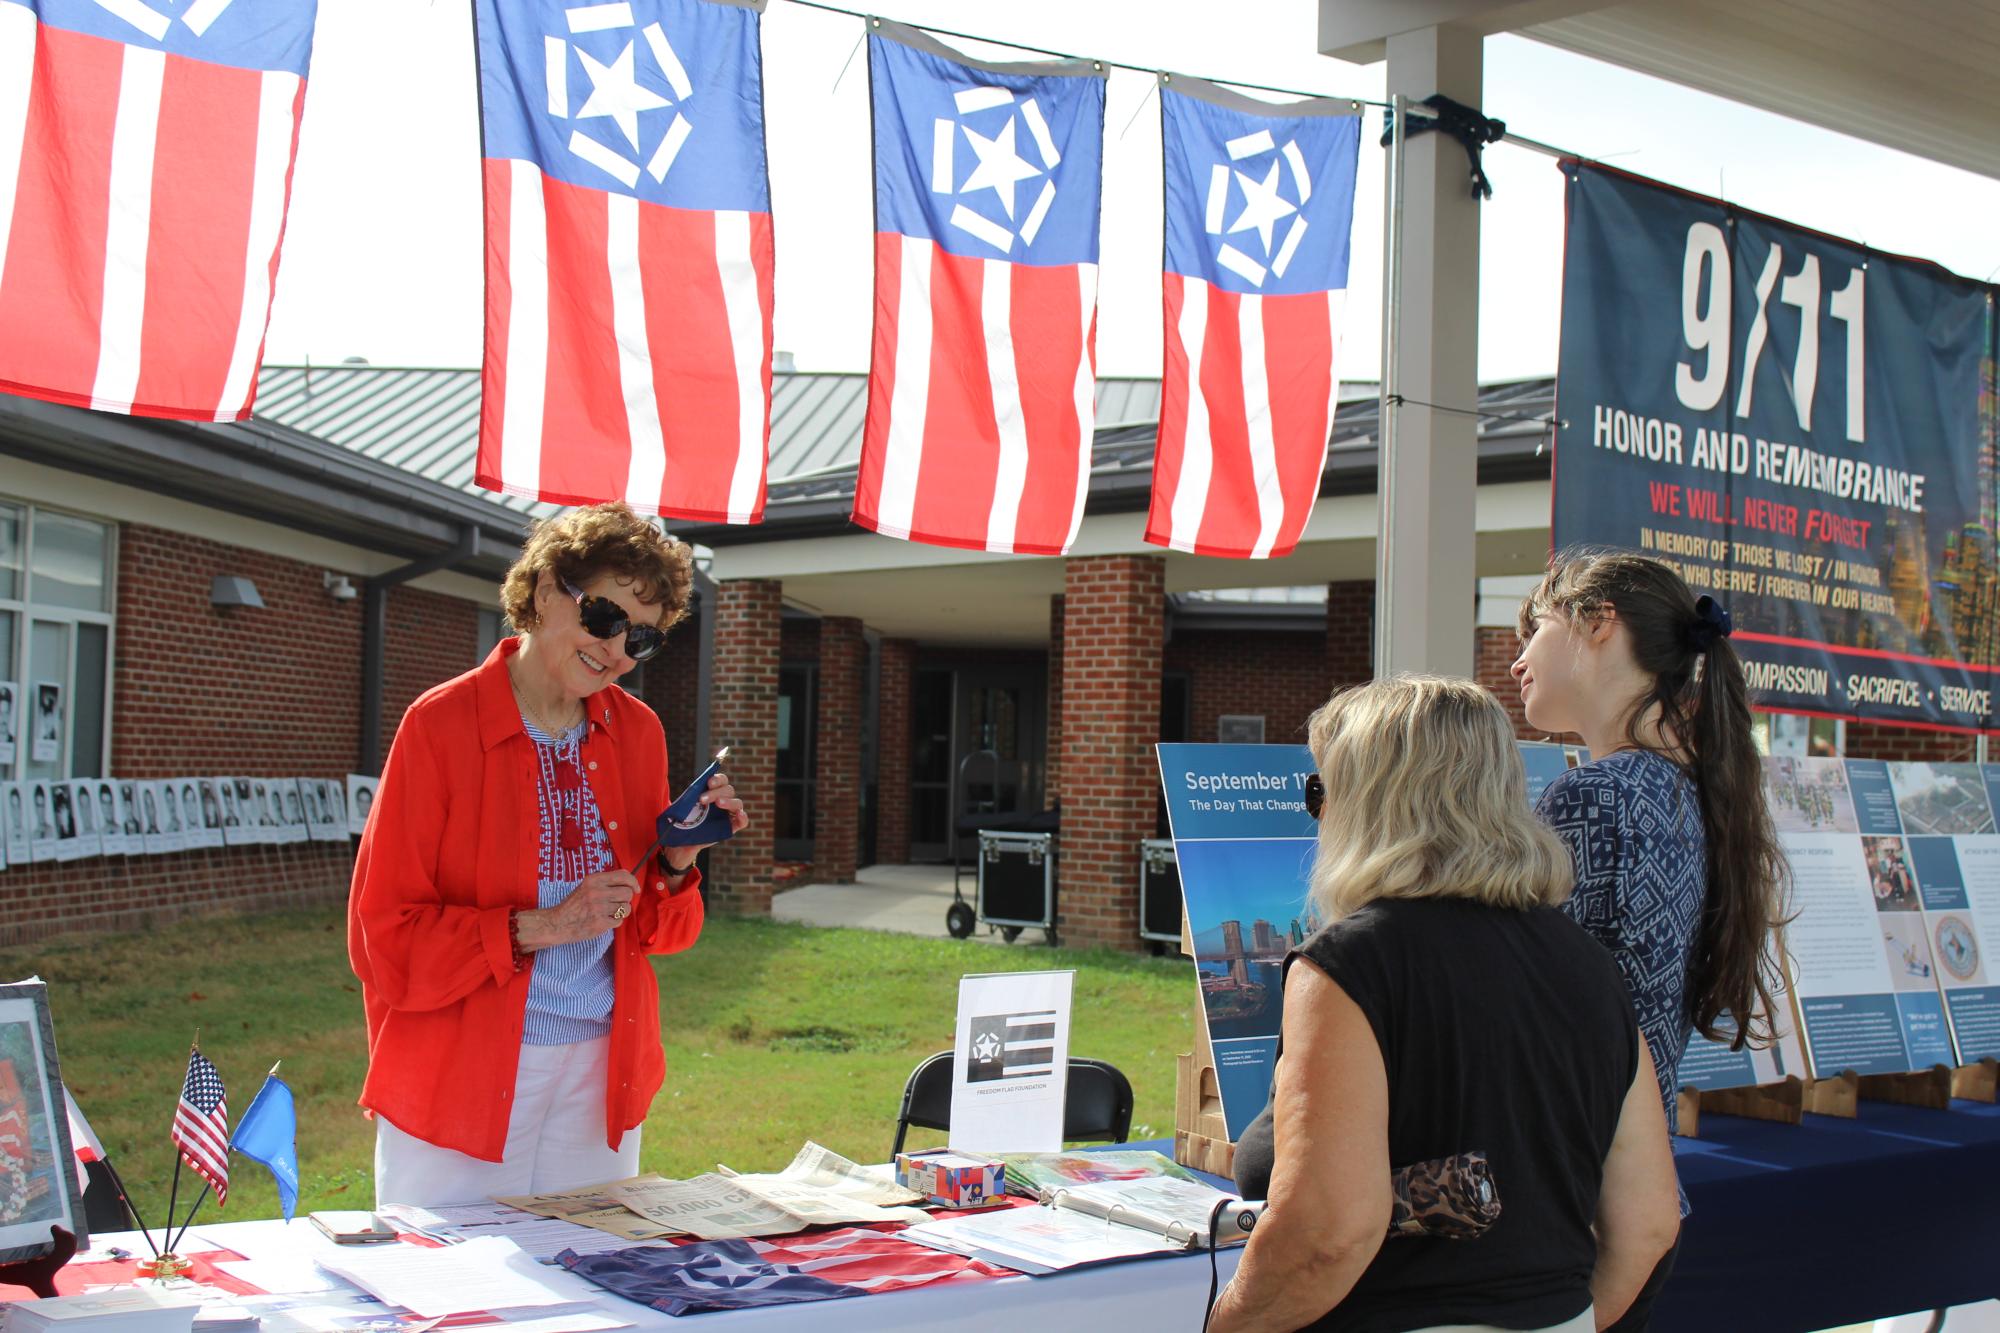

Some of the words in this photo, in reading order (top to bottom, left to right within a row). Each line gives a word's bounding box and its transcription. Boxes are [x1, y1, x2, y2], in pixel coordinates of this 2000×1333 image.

[1675, 221, 1866, 443] 9/11
[1593, 404, 1683, 465] HONOR
[1691, 427, 1749, 475] AND
[1755, 438, 1926, 513] REMEMBRANCE
[1649, 480, 1681, 517] WE
[1686, 487, 1738, 525] WILL
[1744, 496, 1798, 537] NEVER
[1804, 508, 1872, 550] FORGET
[1640, 527, 1654, 549] IN
[1655, 530, 1709, 558] MEMORY
[1710, 540, 1729, 561] OF
[1732, 542, 1774, 569] THOSE
[1774, 548, 1792, 571] WE
[1791, 552, 1825, 577] LOST
[1834, 559, 1848, 580] IN
[1848, 562, 1881, 587] HONOR
[1682, 563, 1711, 587] WHO
[1712, 568, 1757, 593] SERVE
[1766, 575, 1812, 603] FOREVER
[1812, 582, 1829, 606] IN
[1831, 586, 1859, 610] OUR
[1860, 591, 1896, 616] HEARTS
[1738, 658, 1828, 696] OMPASSION
[1846, 674, 1921, 707] SACRIFICE
[1939, 685, 1993, 715] SERVICE
[1185, 771, 1288, 793] September
[1292, 772, 1307, 790] 11
[1189, 799, 1211, 811] The
[1214, 799, 1235, 813] Day
[1238, 799, 1264, 811] That
[643, 1198, 723, 1219] 50,000
